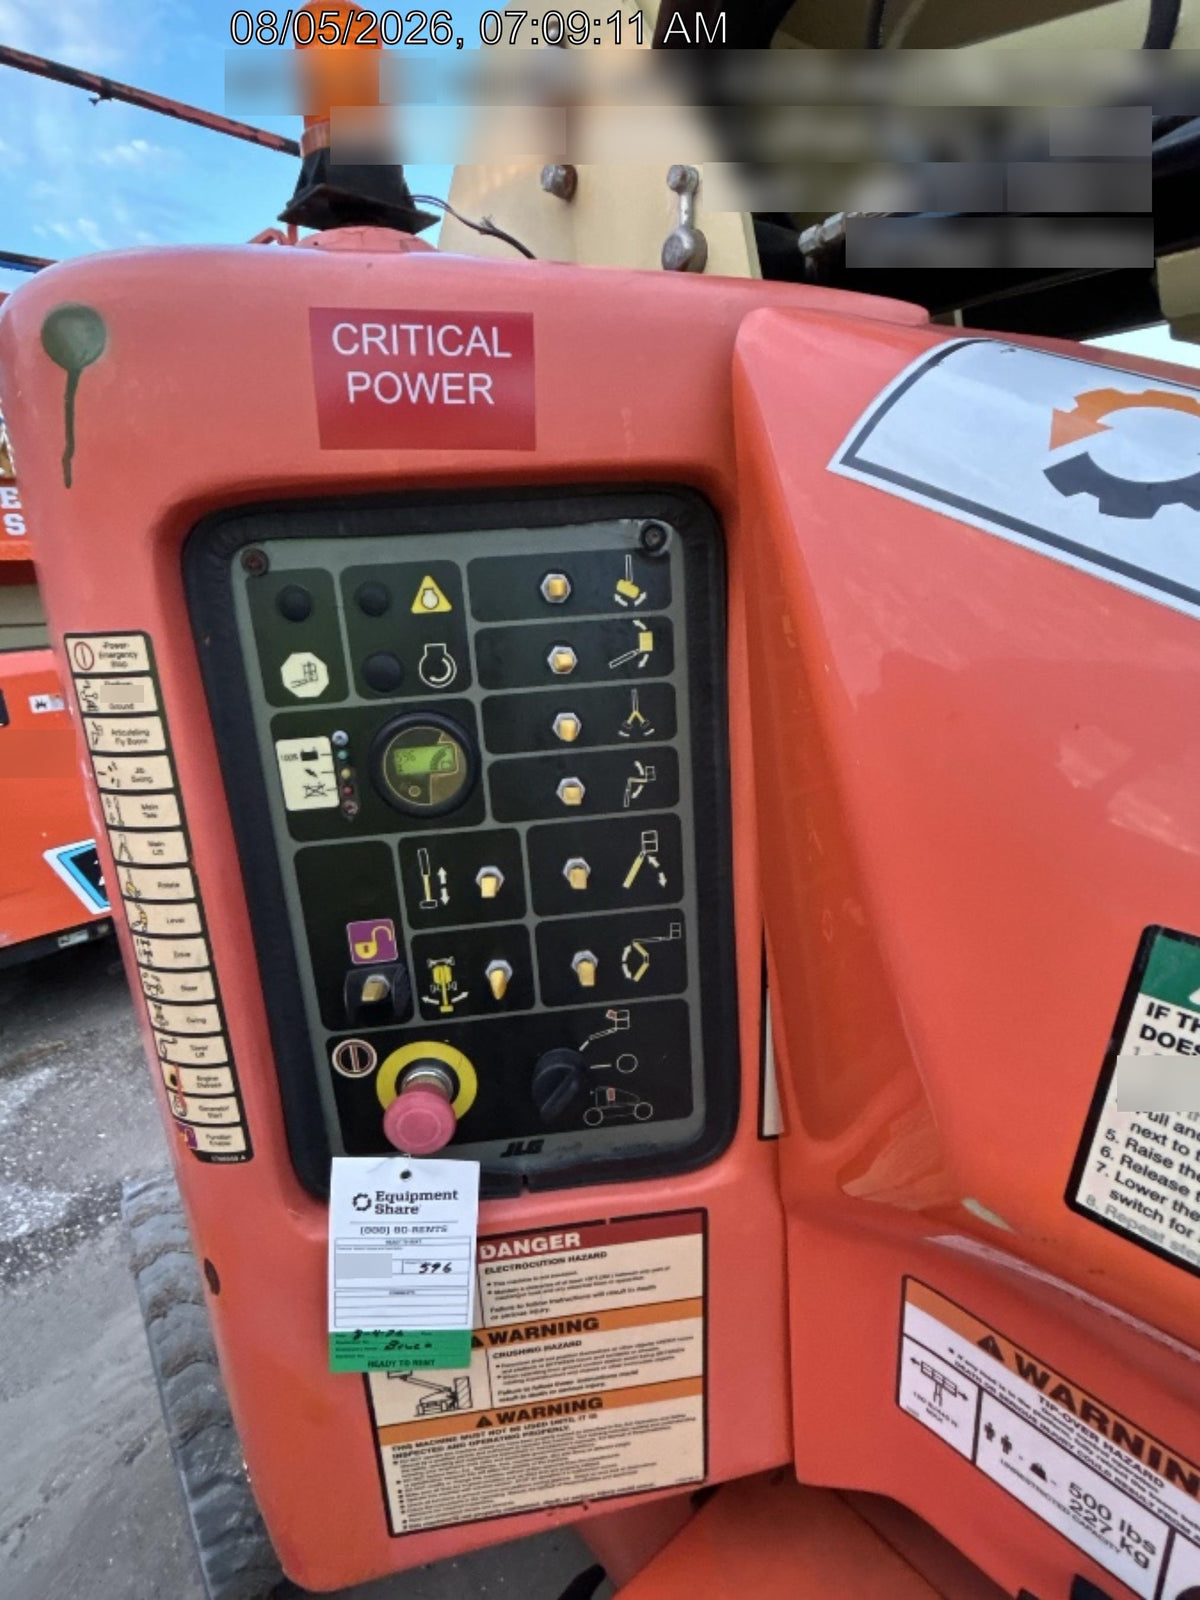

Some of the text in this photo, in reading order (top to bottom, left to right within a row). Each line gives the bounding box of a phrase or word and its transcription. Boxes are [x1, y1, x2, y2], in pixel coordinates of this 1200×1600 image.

[332, 322, 512, 358] CRITICAL
[346, 371, 495, 404] POWER
[99, 651, 137, 659] Emergency
[1146, 1002, 1170, 1019] IF
[500, 1139, 544, 1157] JLG
[1106, 1128, 1119, 1143] 5.
[1125, 1137, 1173, 1168] Raise
[1130, 1122, 1190, 1155] next to
[1100, 1146, 1190, 1195] 6. Release
[375, 1190, 458, 1204] Equipment
[1096, 1161, 1200, 1221] 7. Lower the
[375, 1204, 419, 1214] Share
[1105, 1205, 1165, 1243] Repeat
[1109, 1190, 1195, 1238] switch for
[480, 1233, 581, 1259] DANGER
[485, 1252, 607, 1275] ELECTROCUTION HAZARD
[549, 1295, 591, 1304] instructions
[487, 1317, 599, 1345] WARNING
[368, 1360, 396, 1368] READY
[493, 1340, 582, 1358] CRUSHING HAZARD
[496, 1397, 603, 1424] WARNING
[1015, 1352, 1200, 1497] WARNIN
[1041, 1407, 1075, 1433] Ground
[392, 1444, 412, 1452] THIS
[416, 1437, 457, 1448] MACHINE
[460, 1432, 485, 1441] MUST
[488, 1428, 507, 1436] NOT
[524, 1422, 548, 1431] USED
[551, 1417, 576, 1426] UNTIL
[392, 1446, 444, 1459] INSPECTED
[447, 1442, 466, 1450] AND
[469, 1433, 520, 1446] OPERATING
[955, 1361, 982, 1384] DEATH
[984, 1382, 997, 1393] OR
[999, 1392, 1037, 1424] SERIOUS
[1040, 1423, 1074, 1449] INJURY
[1077, 1450, 1112, 1477] COULD
[1115, 1477, 1155, 1508] RESULT
[1157, 1508, 1191, 1534] FROM
[1039, 1394, 1164, 1488] TIP-OVER HAZARD
[1017, 1397, 1031, 1409] the
[1096, 1455, 1128, 1480] retract
[1131, 1479, 1147, 1493] the
[1149, 1492, 1179, 1515] boom
[1000, 1458, 1120, 1554] UNRESTRICTED CAPACITY
[1069, 1482, 1112, 1520] 500
[1120, 1519, 1156, 1555] lbs
[1069, 1499, 1150, 1569] 227 kg
